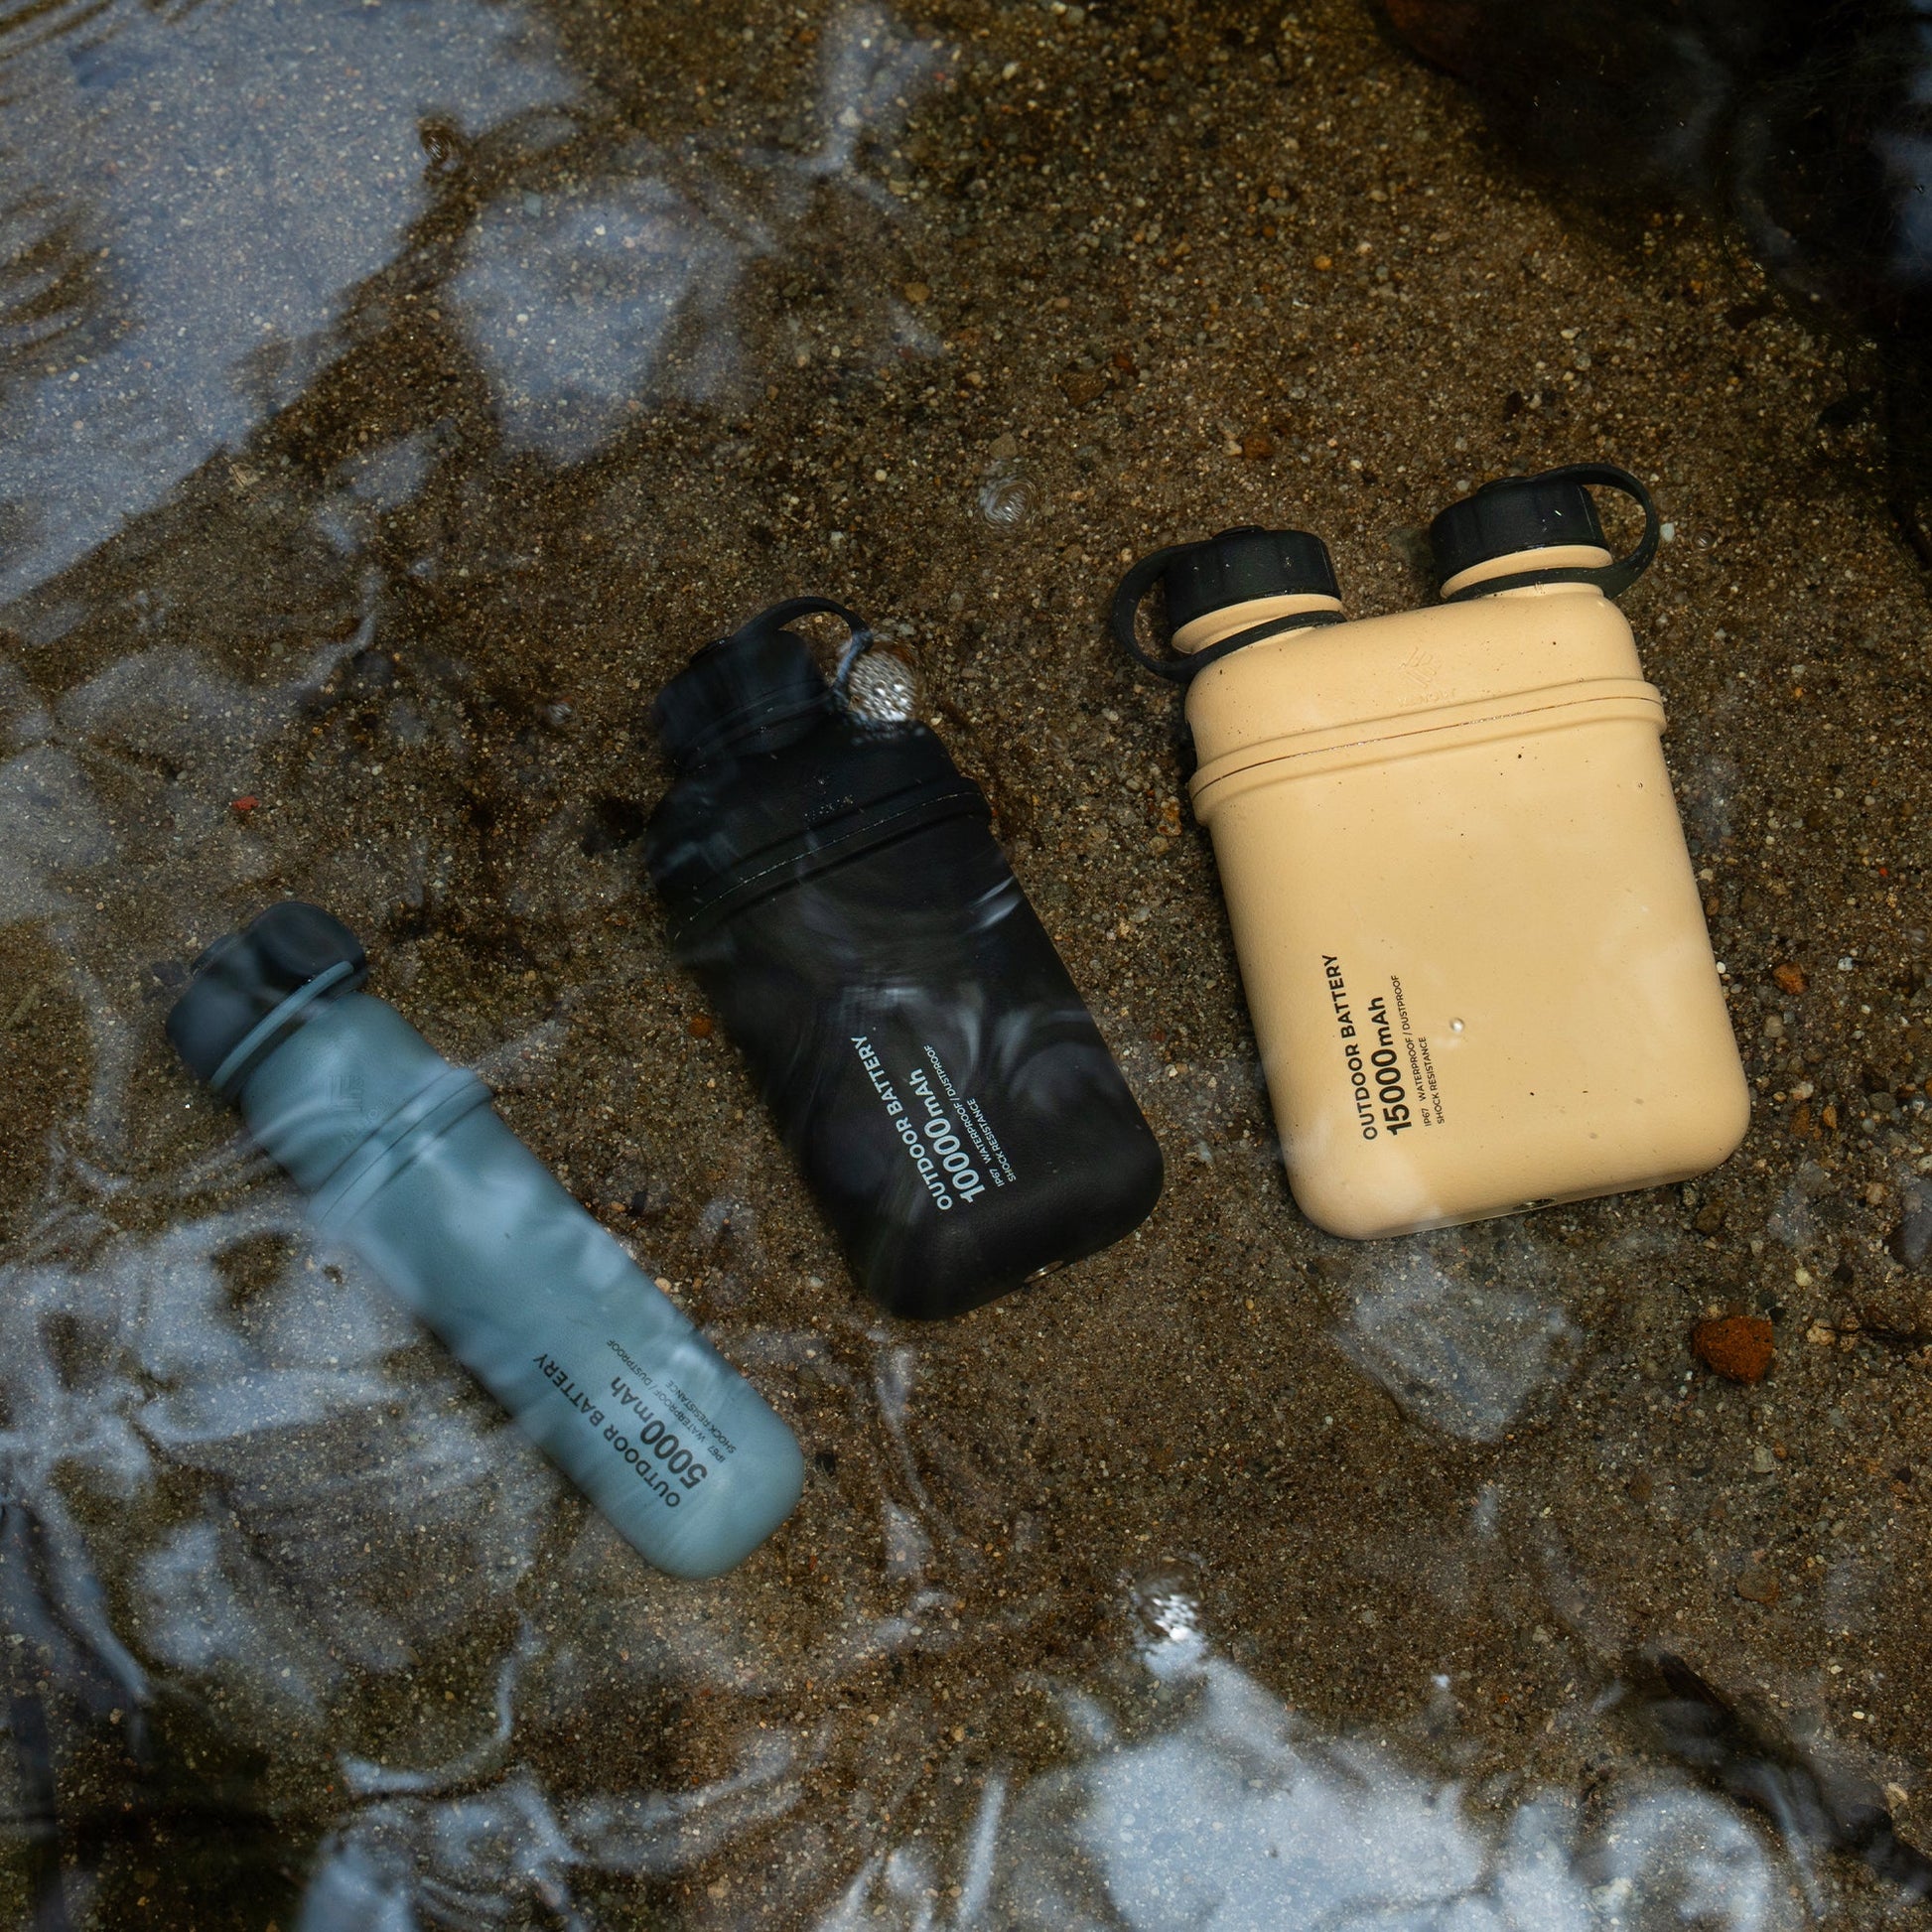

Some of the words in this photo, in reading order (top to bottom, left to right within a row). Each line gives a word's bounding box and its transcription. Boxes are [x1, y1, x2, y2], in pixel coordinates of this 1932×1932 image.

[1321, 955, 1356, 1038] BATTERY
[1391, 975, 1410, 1031] DUSTPROOF
[851, 1035, 903, 1116] BATTERY
[923, 1044, 956, 1097] DUSTPROOF
[1367, 996, 1412, 1136] 15000mAh
[1405, 1037, 1427, 1102] WATERPROOF
[1418, 1036, 1439, 1091] RESISTANCE
[1345, 1043, 1378, 1140] OUTDOOR
[1421, 1108, 1432, 1127] IP67
[1434, 1092, 1446, 1125] SHOCK
[908, 1067, 986, 1203] 10000mAh
[953, 1102, 992, 1165] WATERPROOF
[966, 1098, 1001, 1152] RESISTANCE
[896, 1116, 953, 1210] OUTDOOR
[989, 1168, 1005, 1187] IP67
[995, 1150, 1017, 1182] SHOCK
[533, 1353, 606, 1428] BATTERY
[607, 1339, 652, 1387] DUSTPROOF
[653, 1389, 706, 1443] WATERPROOF
[665, 1379, 713, 1429] RESISTANCE
[610, 1376, 708, 1489] 5000mAh
[707, 1446, 726, 1463] IP67
[708, 1425, 737, 1454] SHOCK
[603, 1424, 681, 1507] OUTDOOR
